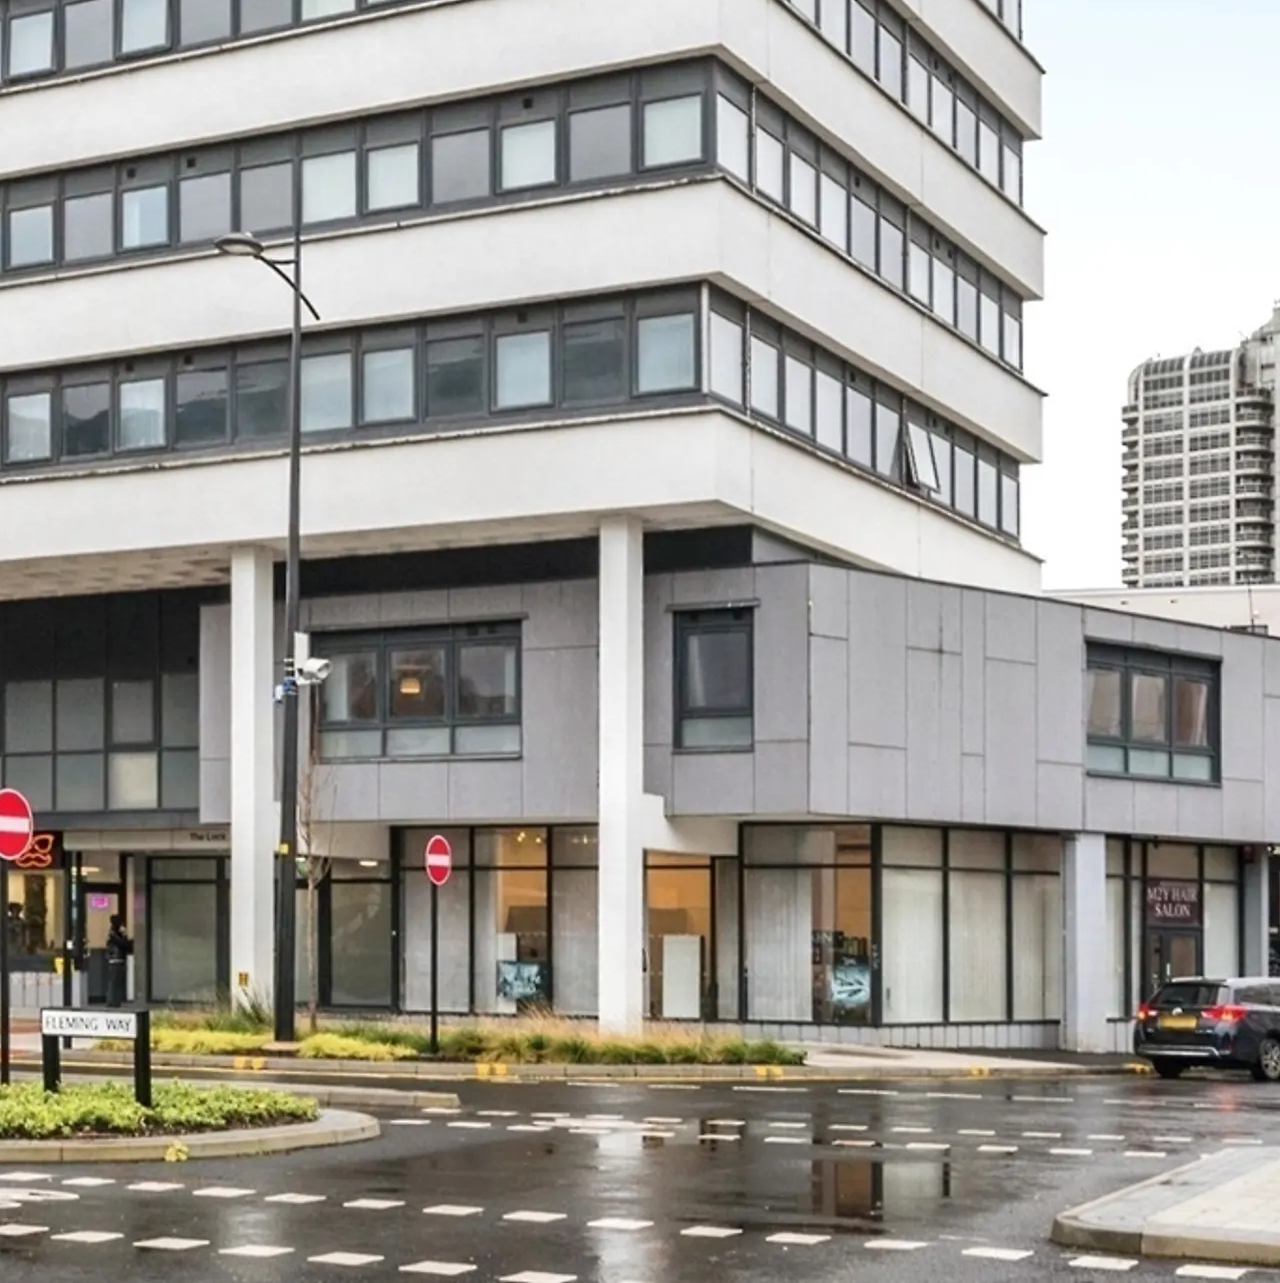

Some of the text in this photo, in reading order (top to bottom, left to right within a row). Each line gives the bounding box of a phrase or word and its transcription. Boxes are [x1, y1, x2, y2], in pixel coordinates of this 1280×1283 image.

[1171, 887, 1198, 903] HAIR
[1155, 902, 1191, 918] SALON
[45, 1015, 132, 1032] FLEMING WAY
